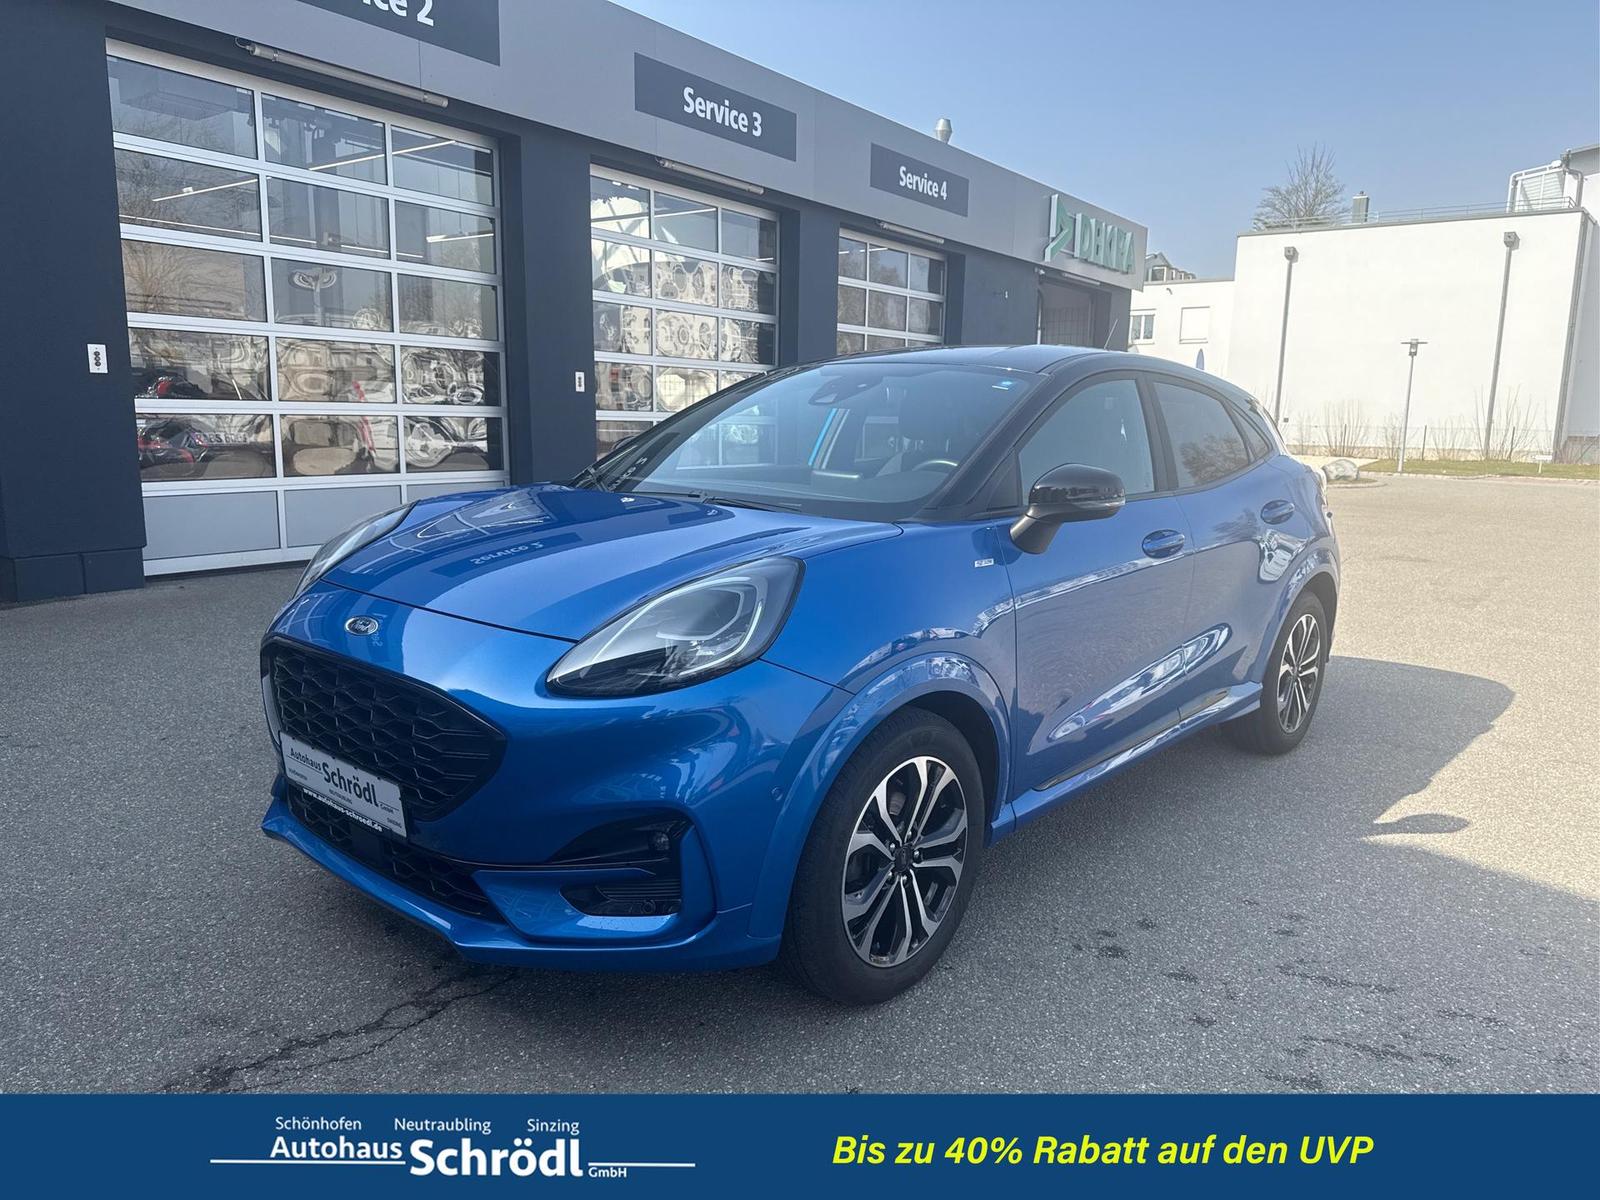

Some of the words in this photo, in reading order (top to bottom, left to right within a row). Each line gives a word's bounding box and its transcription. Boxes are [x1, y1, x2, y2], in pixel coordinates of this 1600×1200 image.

[416, 0, 434, 27] 2
[683, 86, 749, 133] Service
[752, 111, 762, 137] 3
[899, 165, 939, 198] Service
[940, 181, 947, 200] 4
[290, 748, 321, 771] Autohaus
[322, 762, 379, 807] Schrödl
